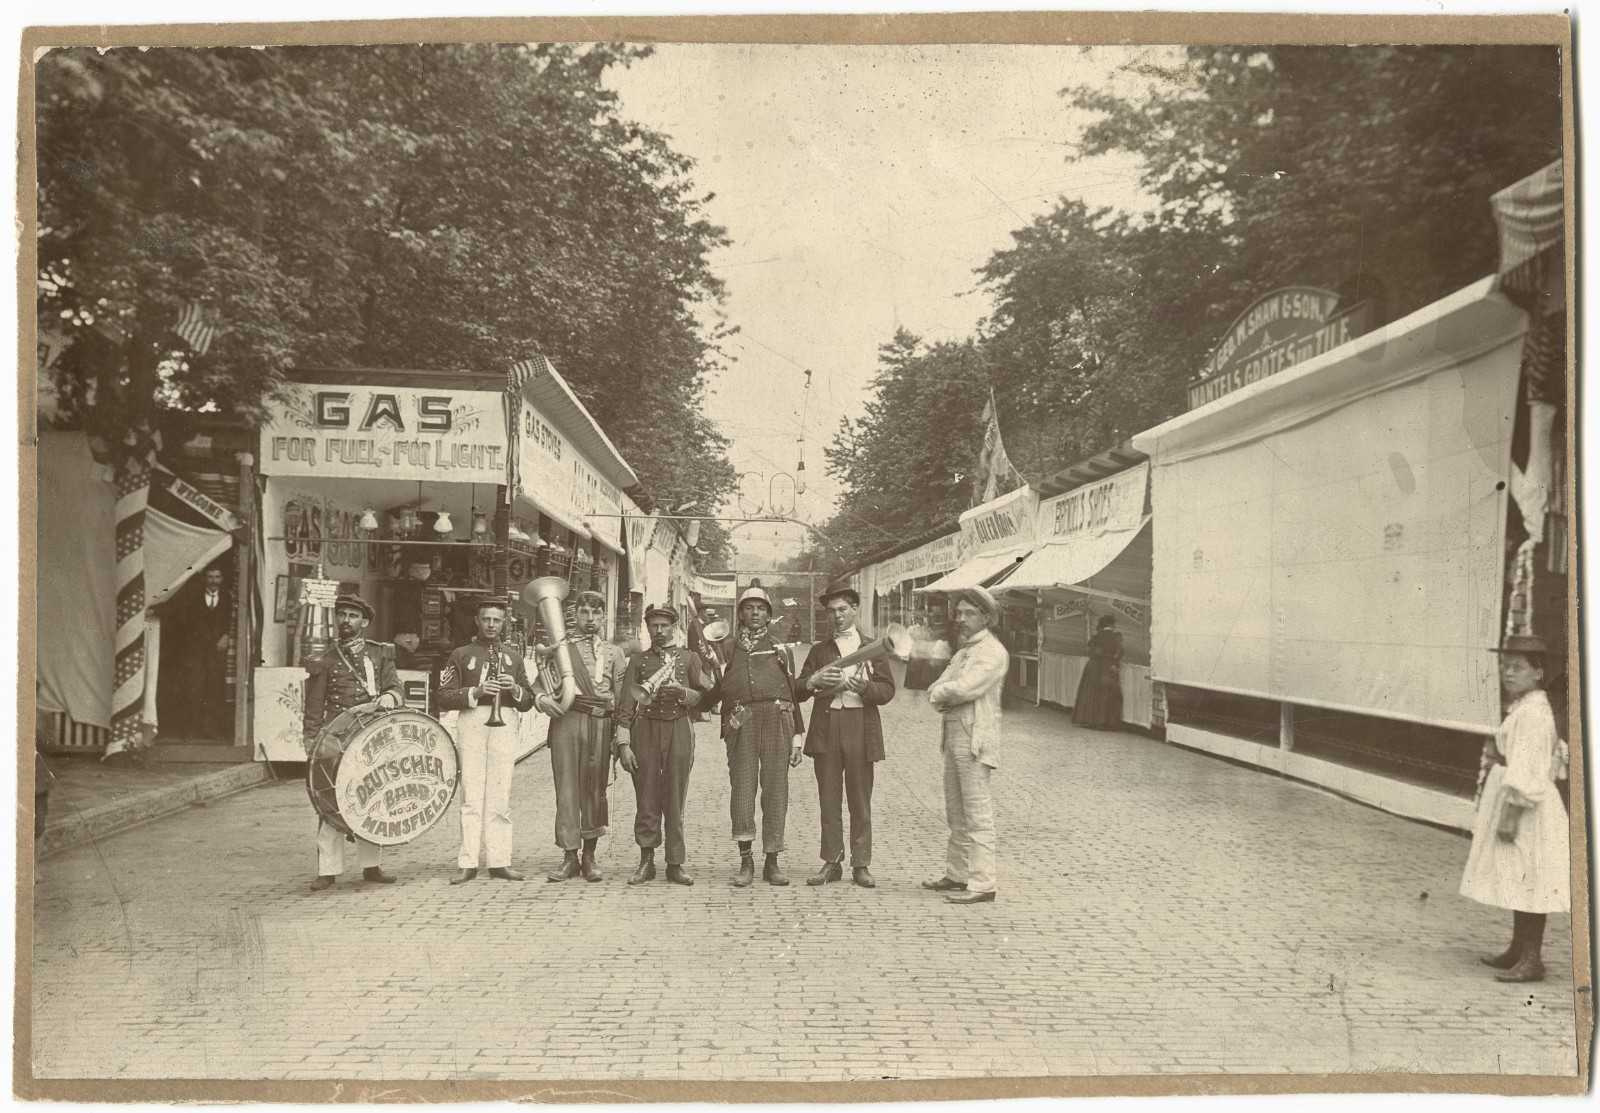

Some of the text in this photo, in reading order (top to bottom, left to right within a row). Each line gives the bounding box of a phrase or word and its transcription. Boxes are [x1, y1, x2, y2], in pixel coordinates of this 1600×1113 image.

[1247, 296, 1280, 335] SHAW
[1244, 342, 1296, 386] GRATES
[313, 391, 453, 434] GAS
[525, 409, 540, 444] GAS
[272, 436, 317, 467] FOR
[325, 438, 382, 468] FUEL
[393, 439, 431, 470] FOR
[176, 481, 224, 520] WELCOME
[361, 726, 395, 764] THE
[355, 755, 445, 808] DEUTSCHER
[384, 784, 430, 811] BAND
